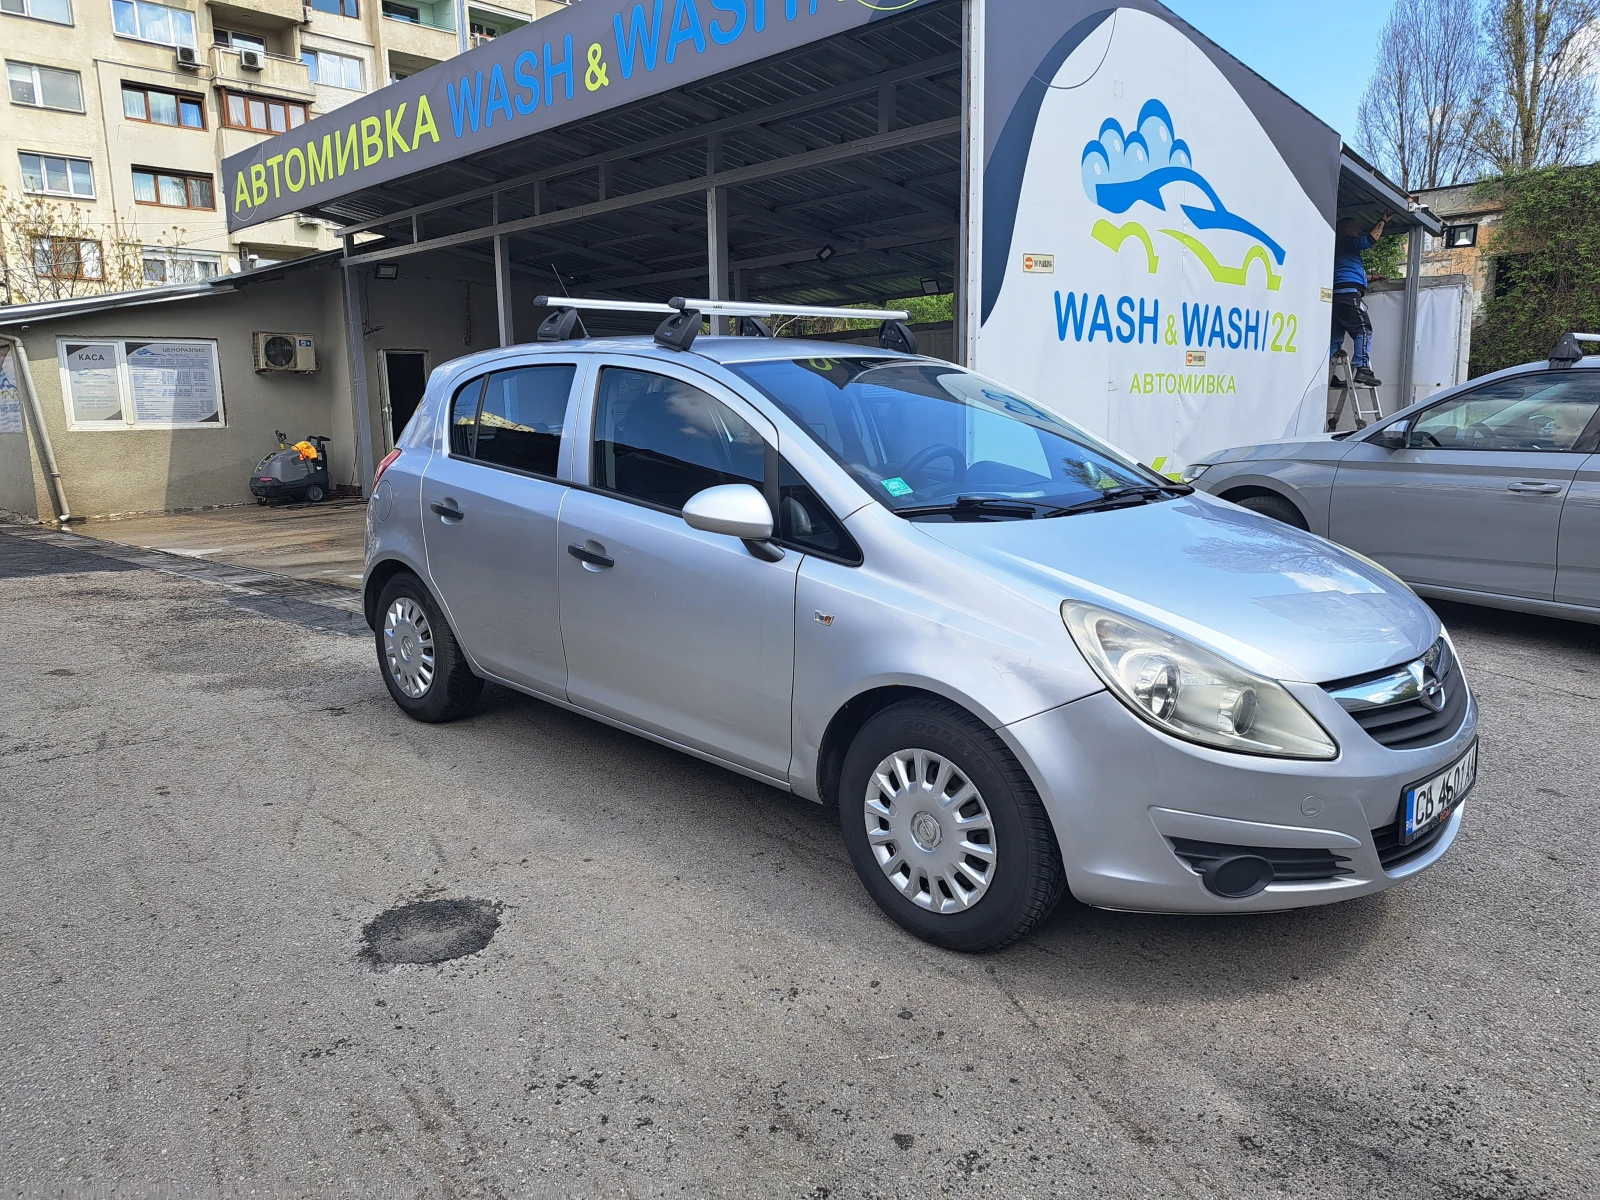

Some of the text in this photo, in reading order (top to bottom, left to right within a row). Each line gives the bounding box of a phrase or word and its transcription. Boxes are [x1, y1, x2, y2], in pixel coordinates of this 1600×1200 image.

[234, 94, 440, 213] АВТОМИВКА
[447, 33, 574, 138] WASH
[584, 43, 610, 92] &
[1053, 290, 1159, 345] WASH
[1164, 314, 1178, 346] &
[78, 353, 105, 361] КАСА
[1128, 373, 1237, 394] АВТОМИВКА
